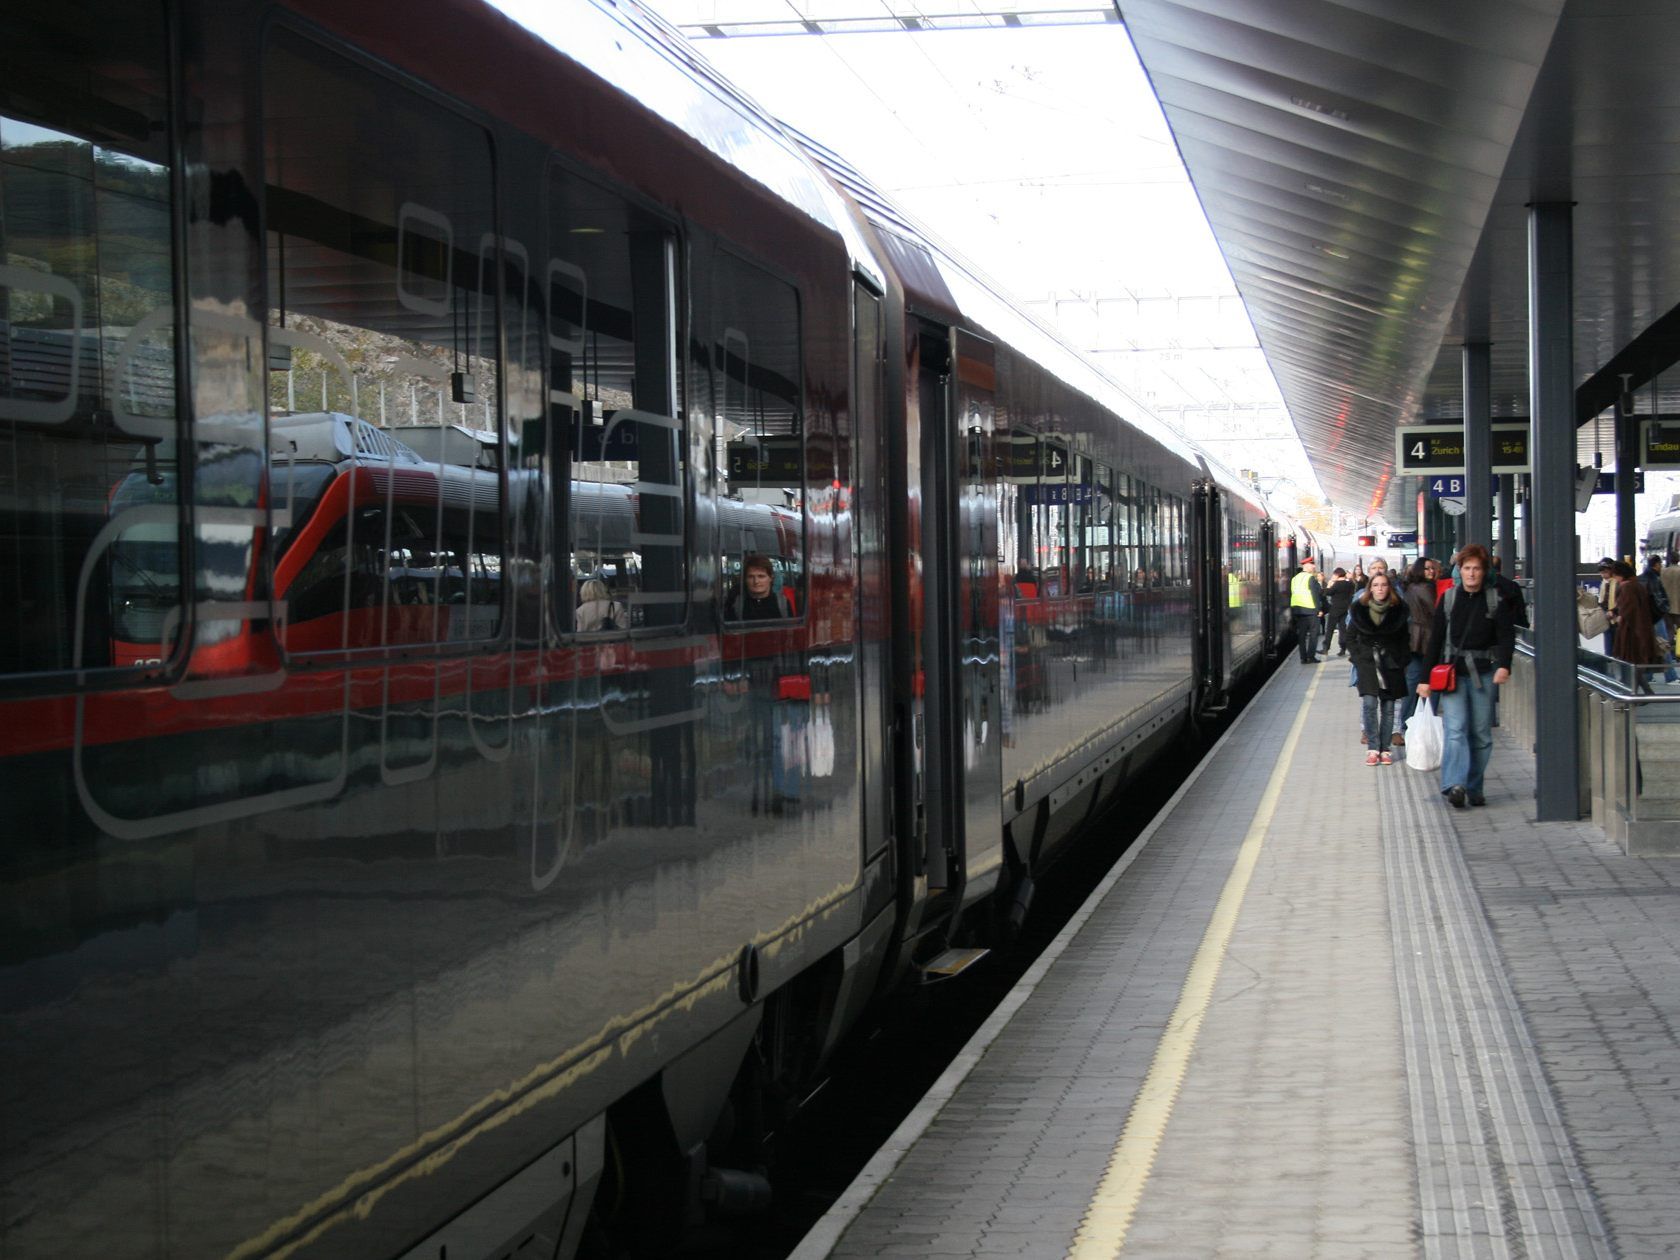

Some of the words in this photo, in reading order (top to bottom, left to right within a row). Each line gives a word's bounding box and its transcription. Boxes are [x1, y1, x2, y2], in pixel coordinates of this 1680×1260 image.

[1411, 441, 1425, 459] 4
[1433, 480, 1444, 493] 4
[1450, 480, 1460, 493] B
